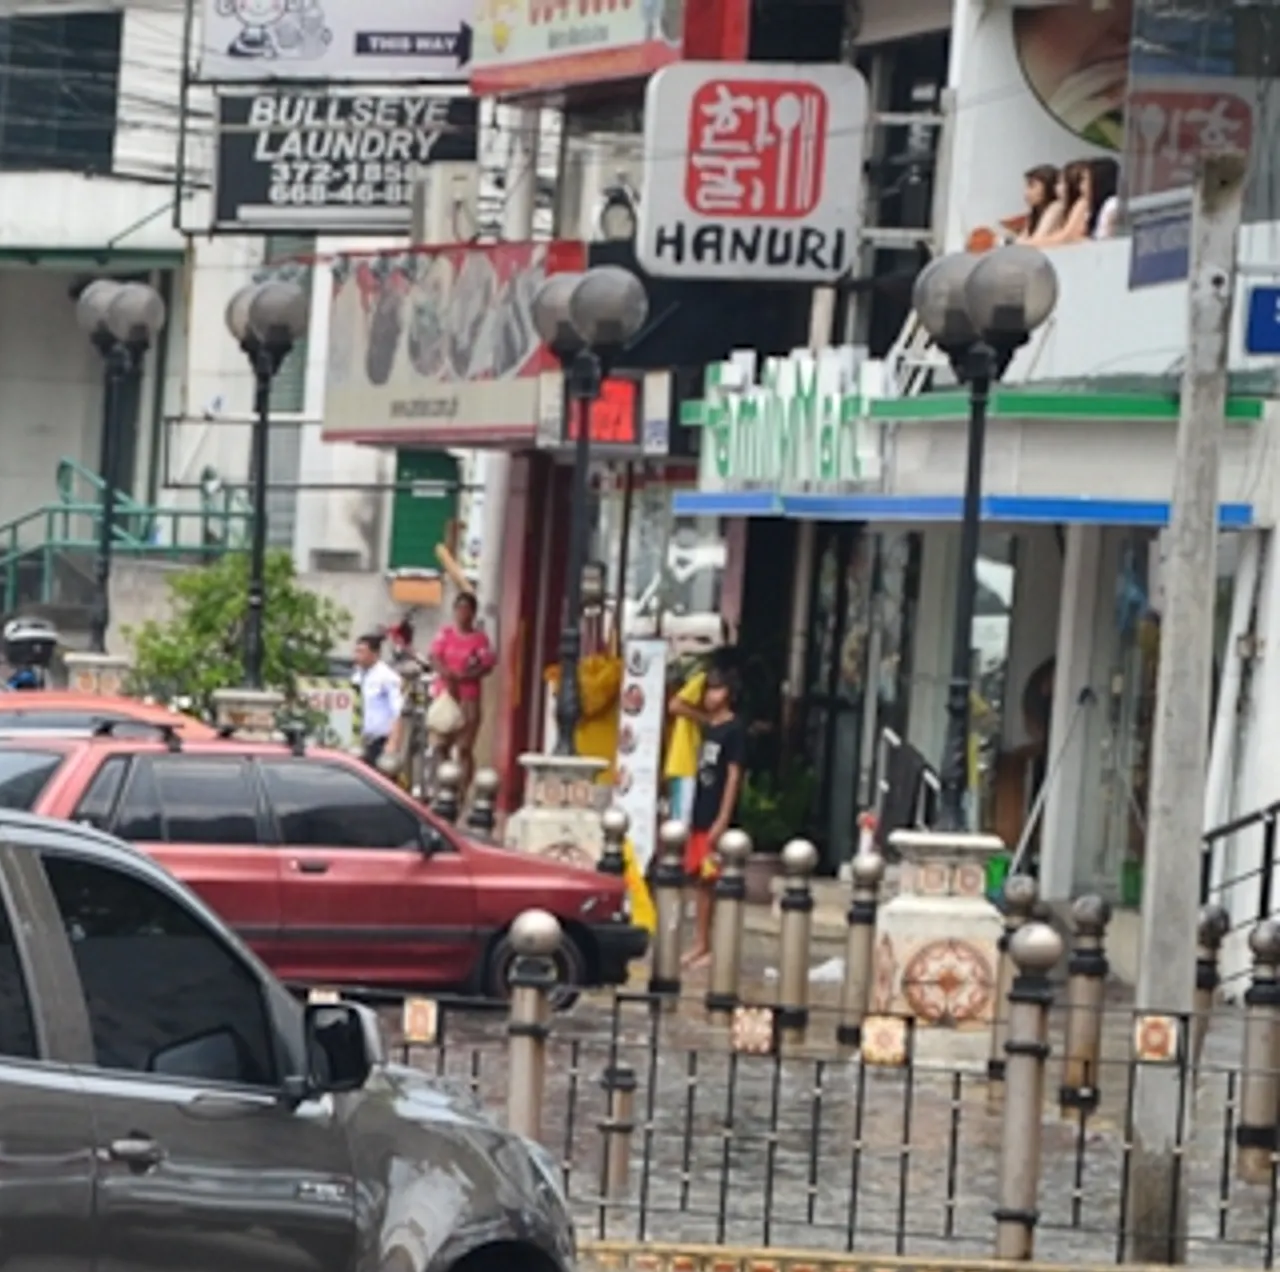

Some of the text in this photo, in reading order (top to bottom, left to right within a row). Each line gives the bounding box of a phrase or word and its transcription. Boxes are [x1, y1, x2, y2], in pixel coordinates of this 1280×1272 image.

[367, 36, 458, 53] THIS WAY
[248, 96, 452, 127] BULLSEYE
[254, 129, 442, 162] LAUNDRY
[655, 220, 846, 273] HANURI
